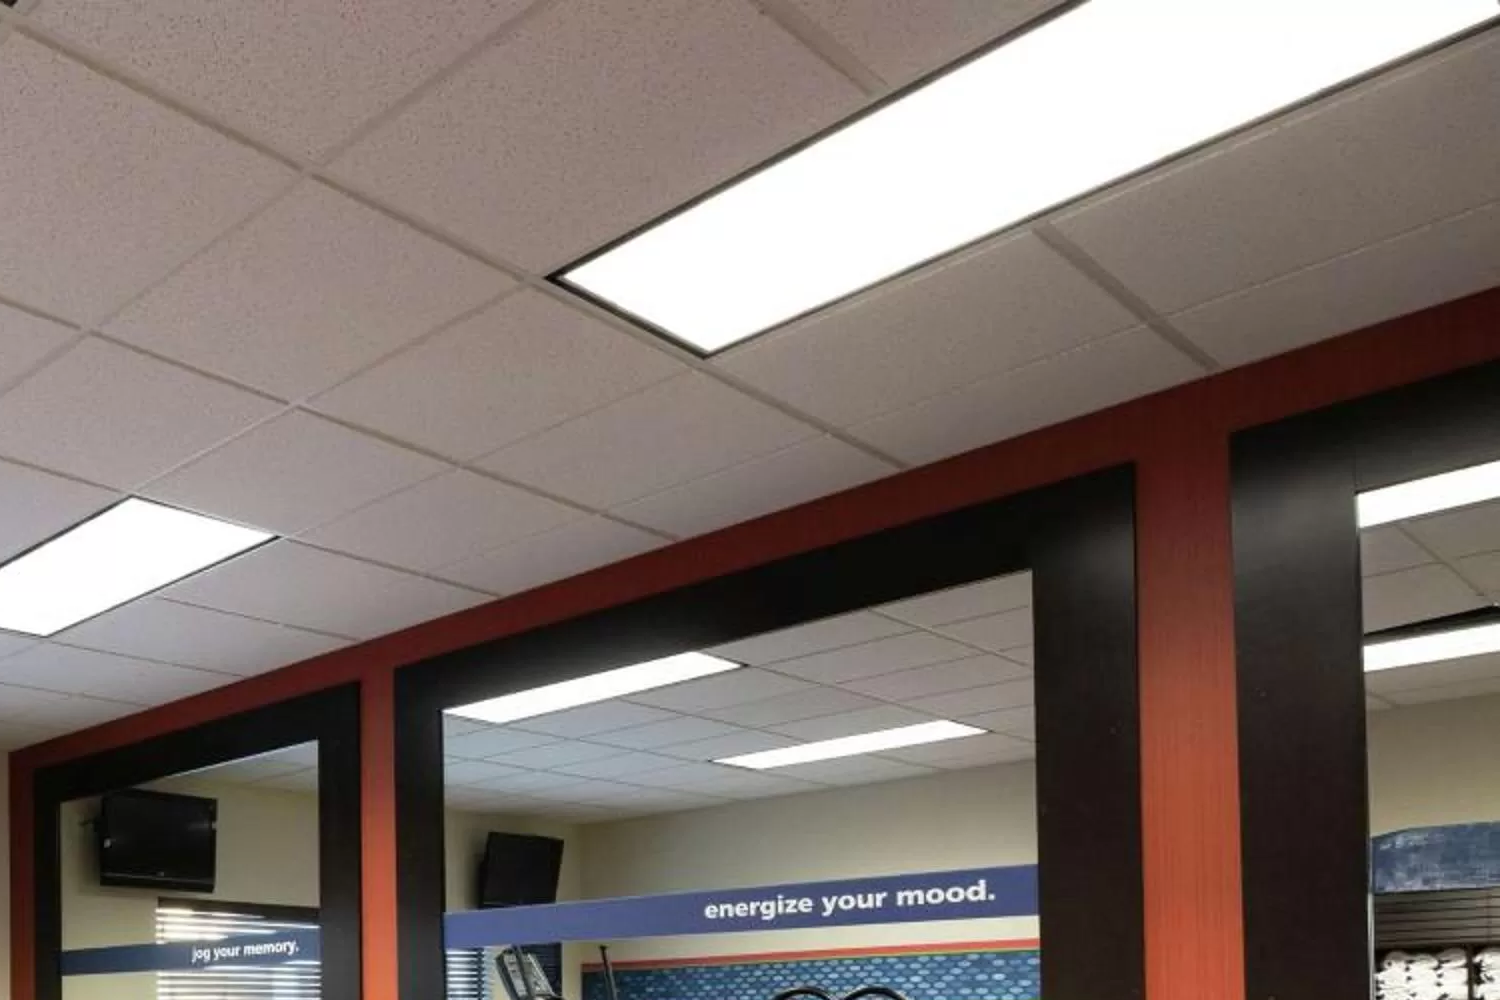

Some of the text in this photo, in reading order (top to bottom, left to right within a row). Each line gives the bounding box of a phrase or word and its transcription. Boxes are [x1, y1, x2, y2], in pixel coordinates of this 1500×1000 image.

[704, 879, 996, 920] energize your mood.
[191, 940, 299, 963] jog your memory.
